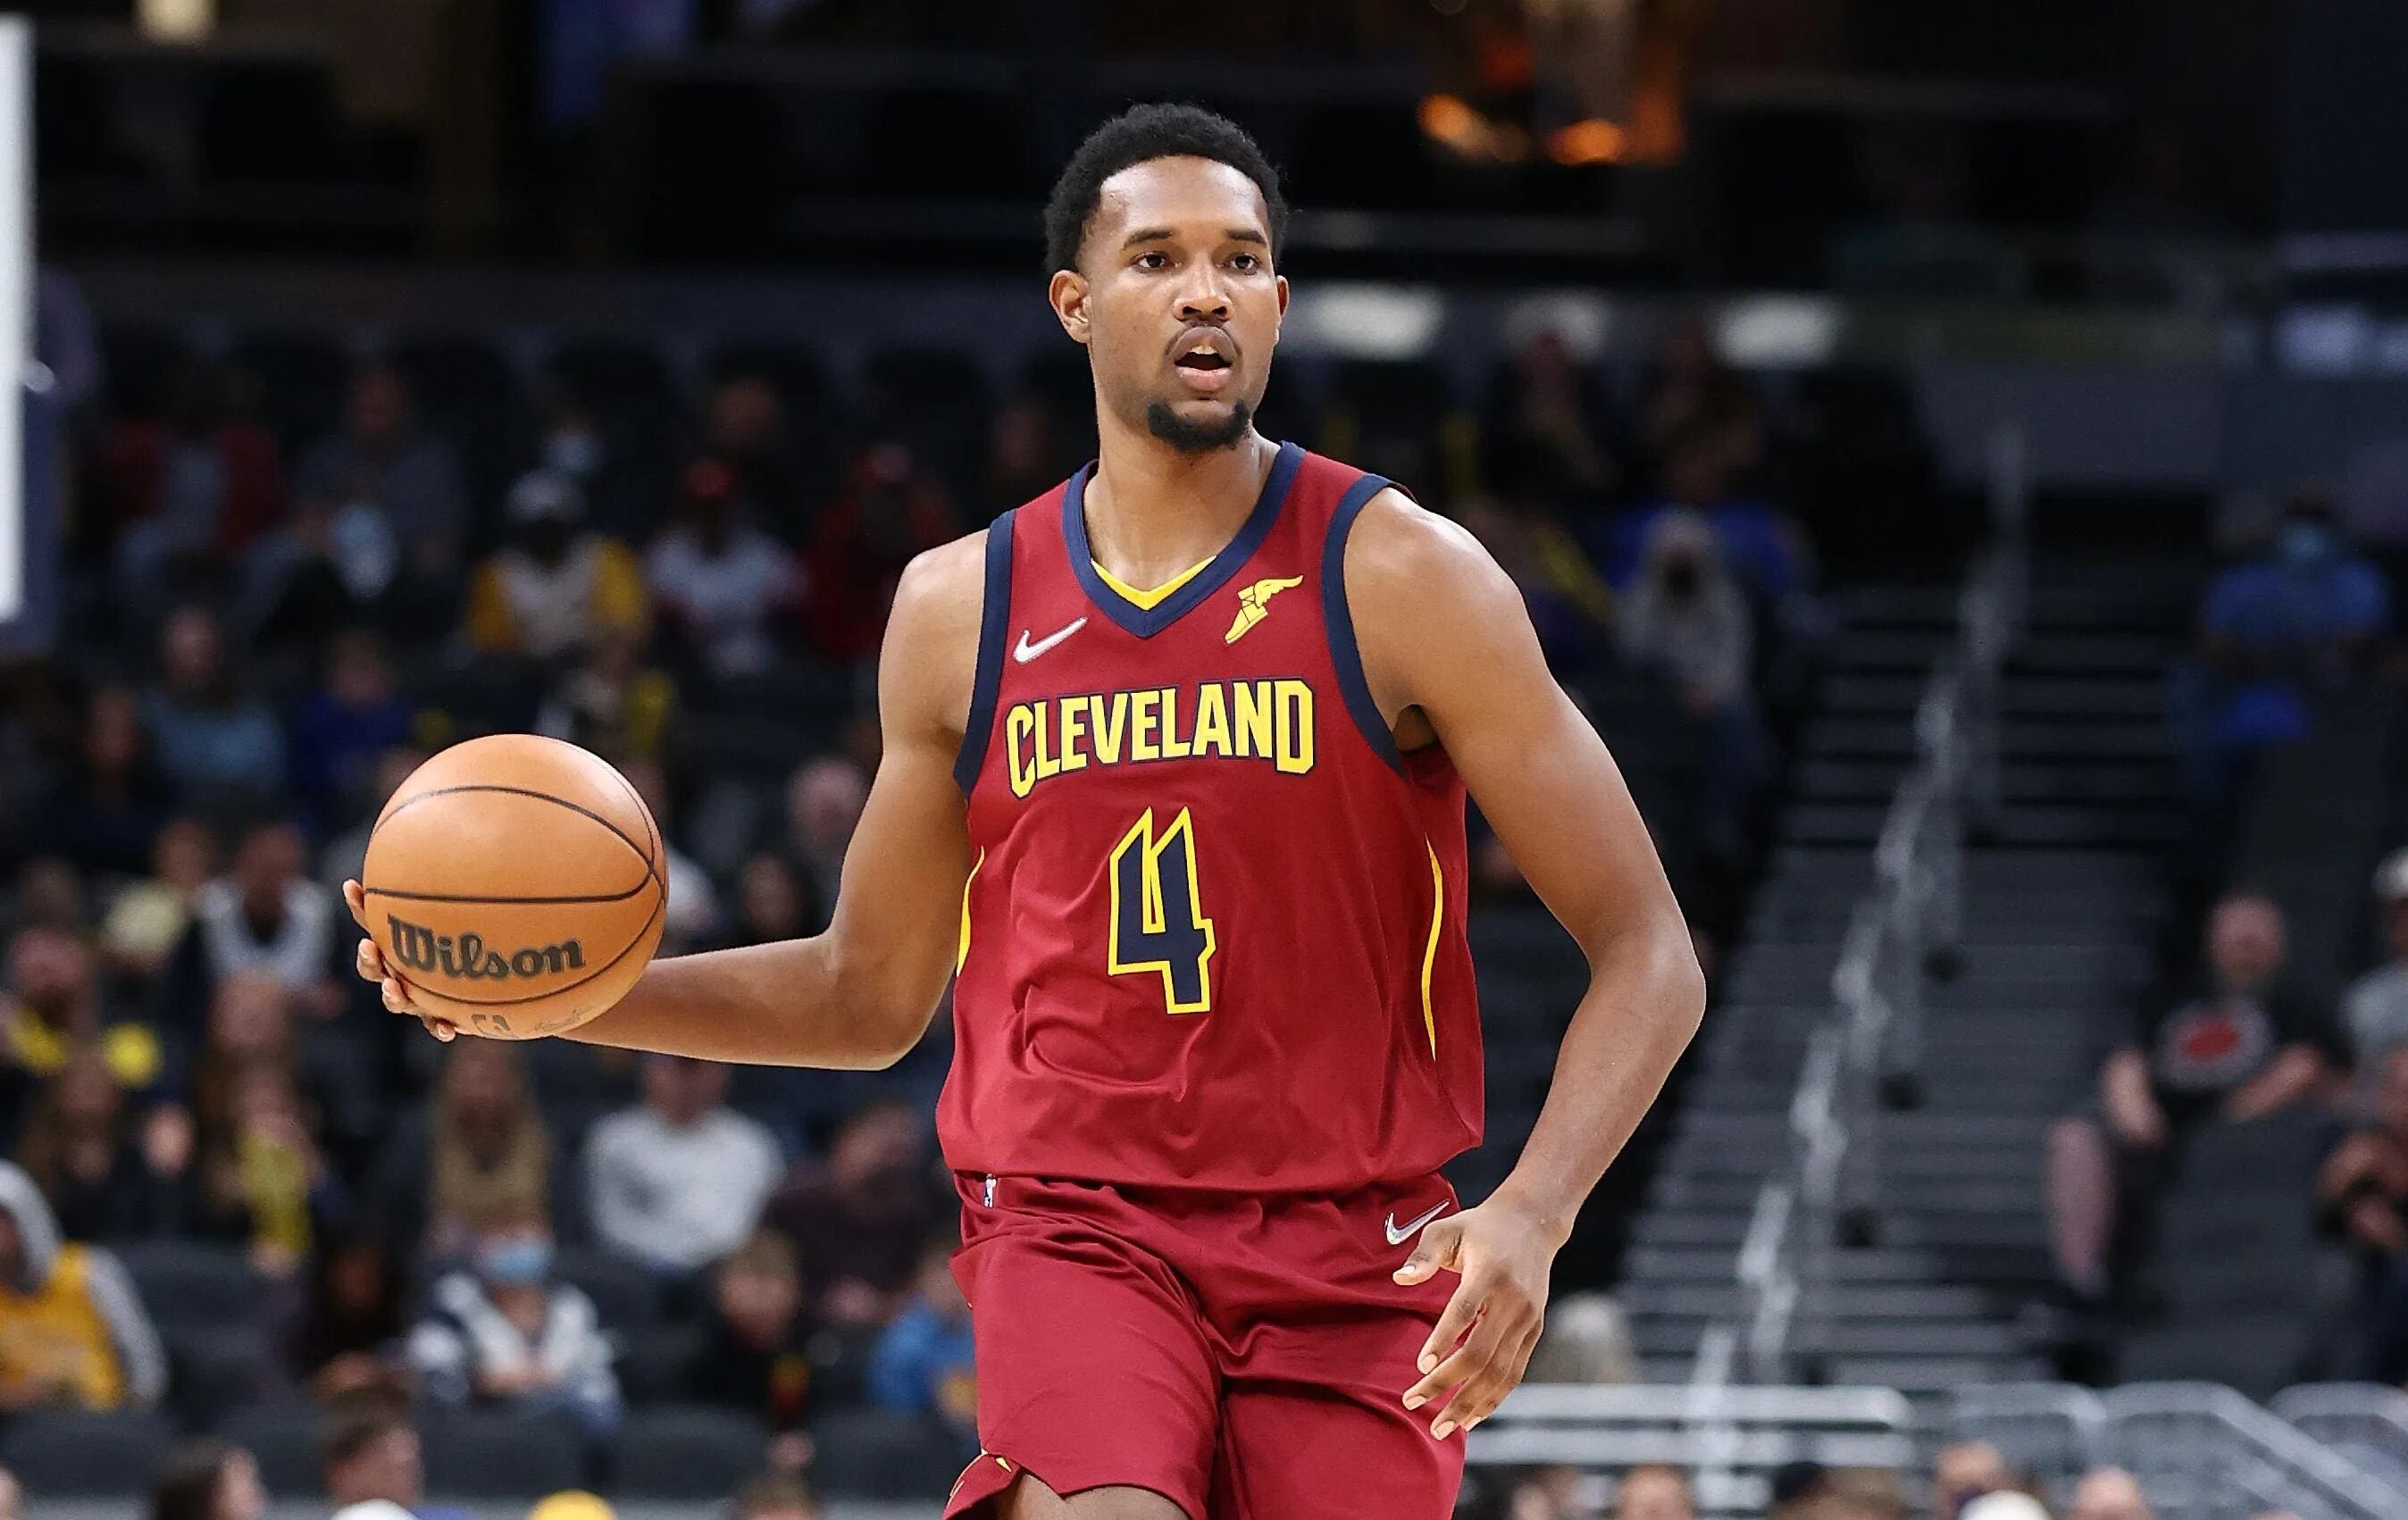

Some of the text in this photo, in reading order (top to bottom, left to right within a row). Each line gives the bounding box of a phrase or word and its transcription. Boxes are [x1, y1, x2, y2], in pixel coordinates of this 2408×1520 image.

[1005, 677, 1317, 799] CLEVELAND
[386, 912, 586, 981] Wilson
[1108, 806, 1217, 1015] 4
